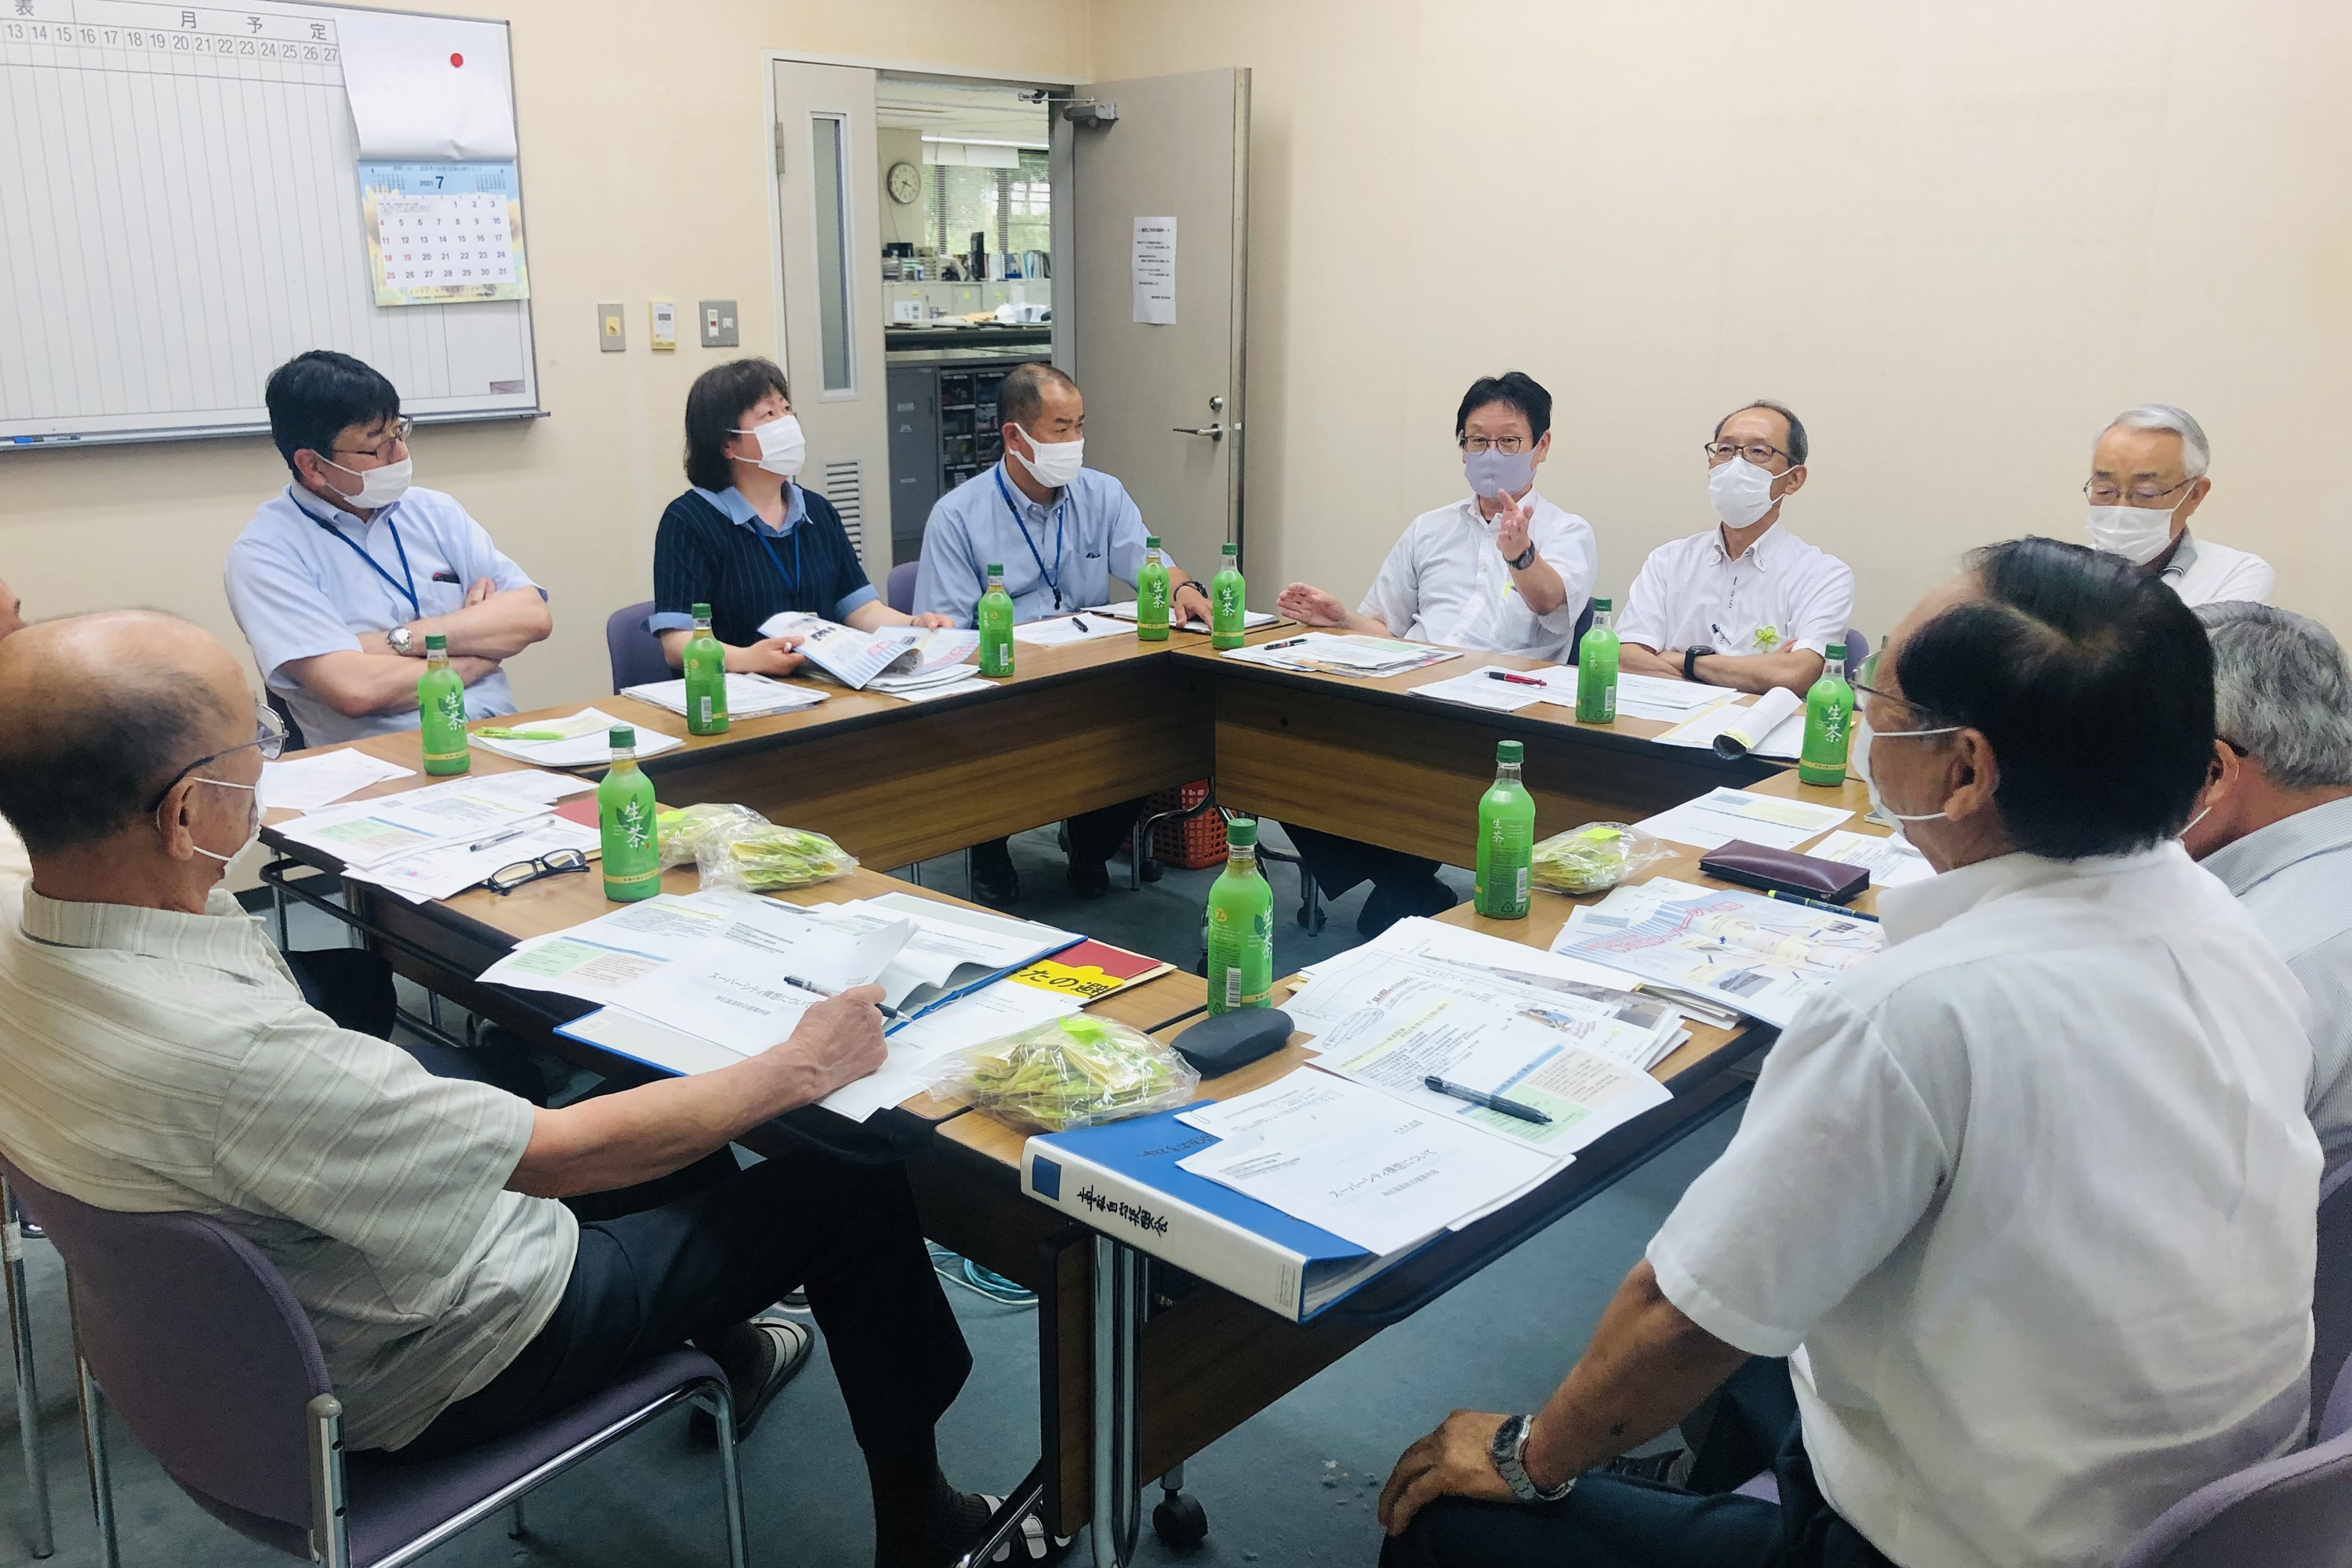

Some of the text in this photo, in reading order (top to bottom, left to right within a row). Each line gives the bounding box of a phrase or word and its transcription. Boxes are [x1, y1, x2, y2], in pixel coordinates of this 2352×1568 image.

[181, 11, 197, 29] 月
[246, 16, 263, 34] 予
[310, 24, 327, 40] 定
[7, 24, 338, 62] 13 14 15 16 17 18 19 20 21 22 23 24 25 26 27
[435, 176, 444, 189] 7
[1152, 580, 1165, 608] 生茶
[1222, 587, 1235, 616] 生茶
[446, 691, 463, 731] 生茶
[1824, 704, 1842, 742] 生茶
[624, 801, 649, 848] 生茶
[1492, 818, 1504, 843] 生茶
